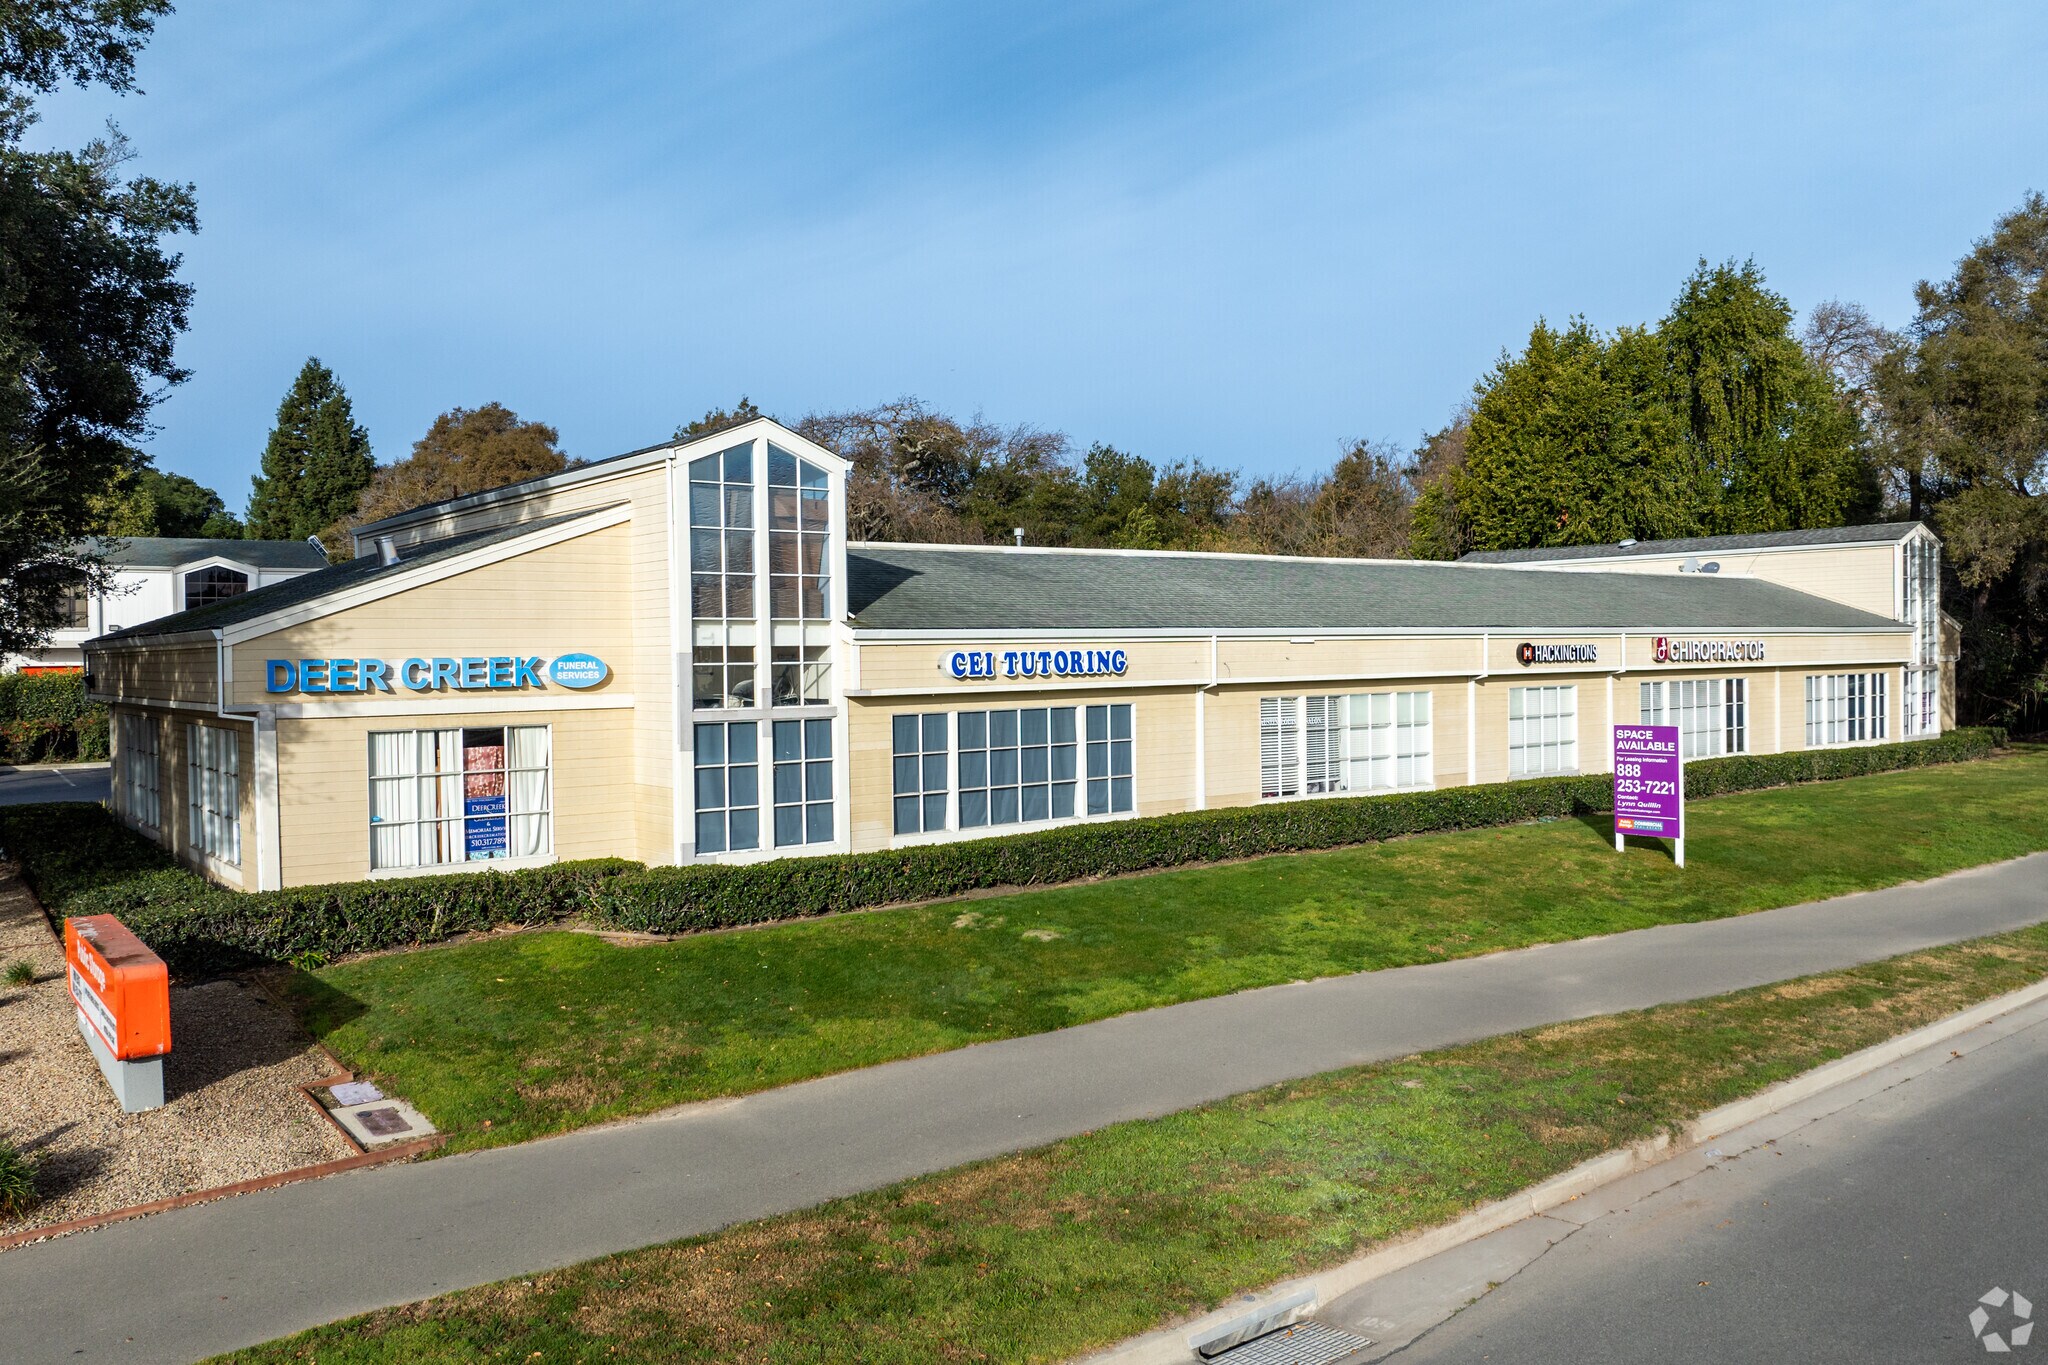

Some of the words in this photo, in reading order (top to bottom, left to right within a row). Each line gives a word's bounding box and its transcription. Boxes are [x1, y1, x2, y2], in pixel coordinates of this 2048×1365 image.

[1535, 643, 1598, 662] HACKINGTONS
[1669, 640, 1765, 662] CHIROPRACTOR
[557, 660, 599, 671] FUNERAL
[951, 651, 994, 677] CEI
[1004, 649, 1127, 676] TUTORING
[265, 658, 390, 693] DEER
[401, 656, 542, 690] CREEK
[556, 670, 601, 680] SERVICES
[1616, 730, 1653, 739] SPACE
[1616, 741, 1675, 751] AVAILABLE
[1617, 764, 1641, 777] 888
[1617, 779, 1675, 795] 253-7221
